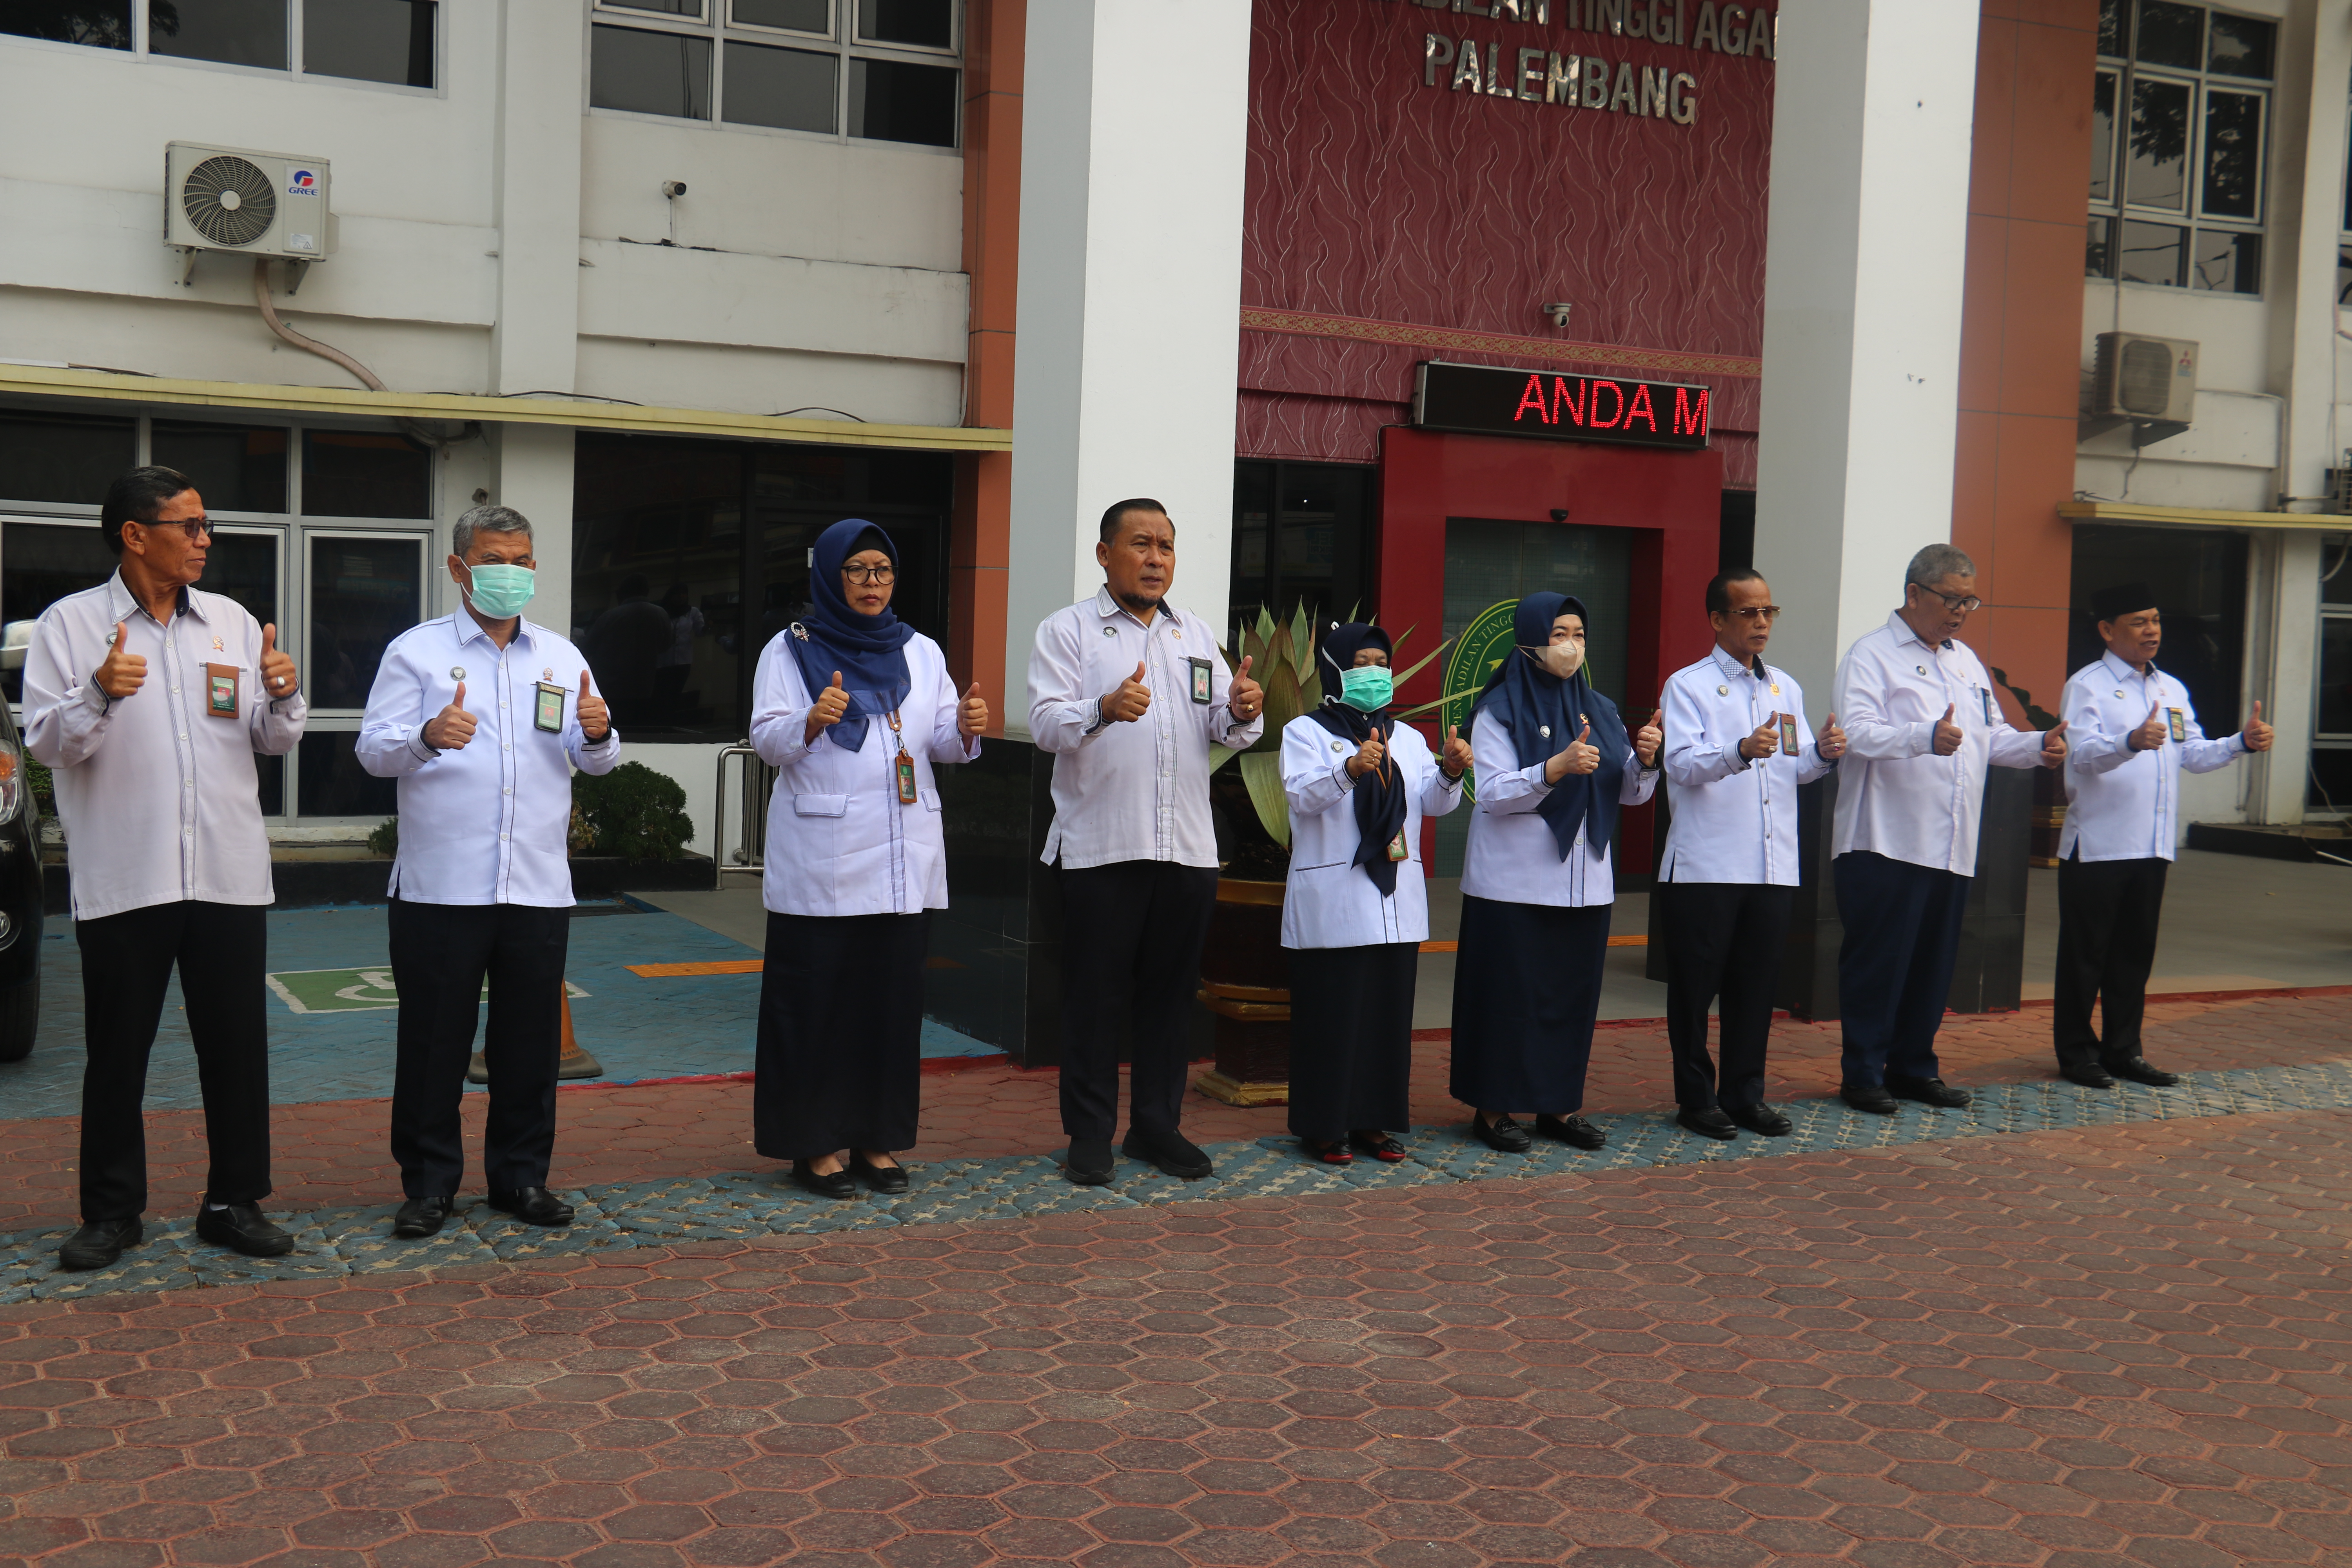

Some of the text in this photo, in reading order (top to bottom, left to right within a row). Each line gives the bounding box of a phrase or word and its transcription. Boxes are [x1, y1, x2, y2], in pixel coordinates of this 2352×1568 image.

[1693, 0, 1779, 61] AGA
[1425, 33, 1696, 125] PALEMBANG
[289, 187, 319, 196] GREE
[1514, 374, 1709, 436] ANDA M
